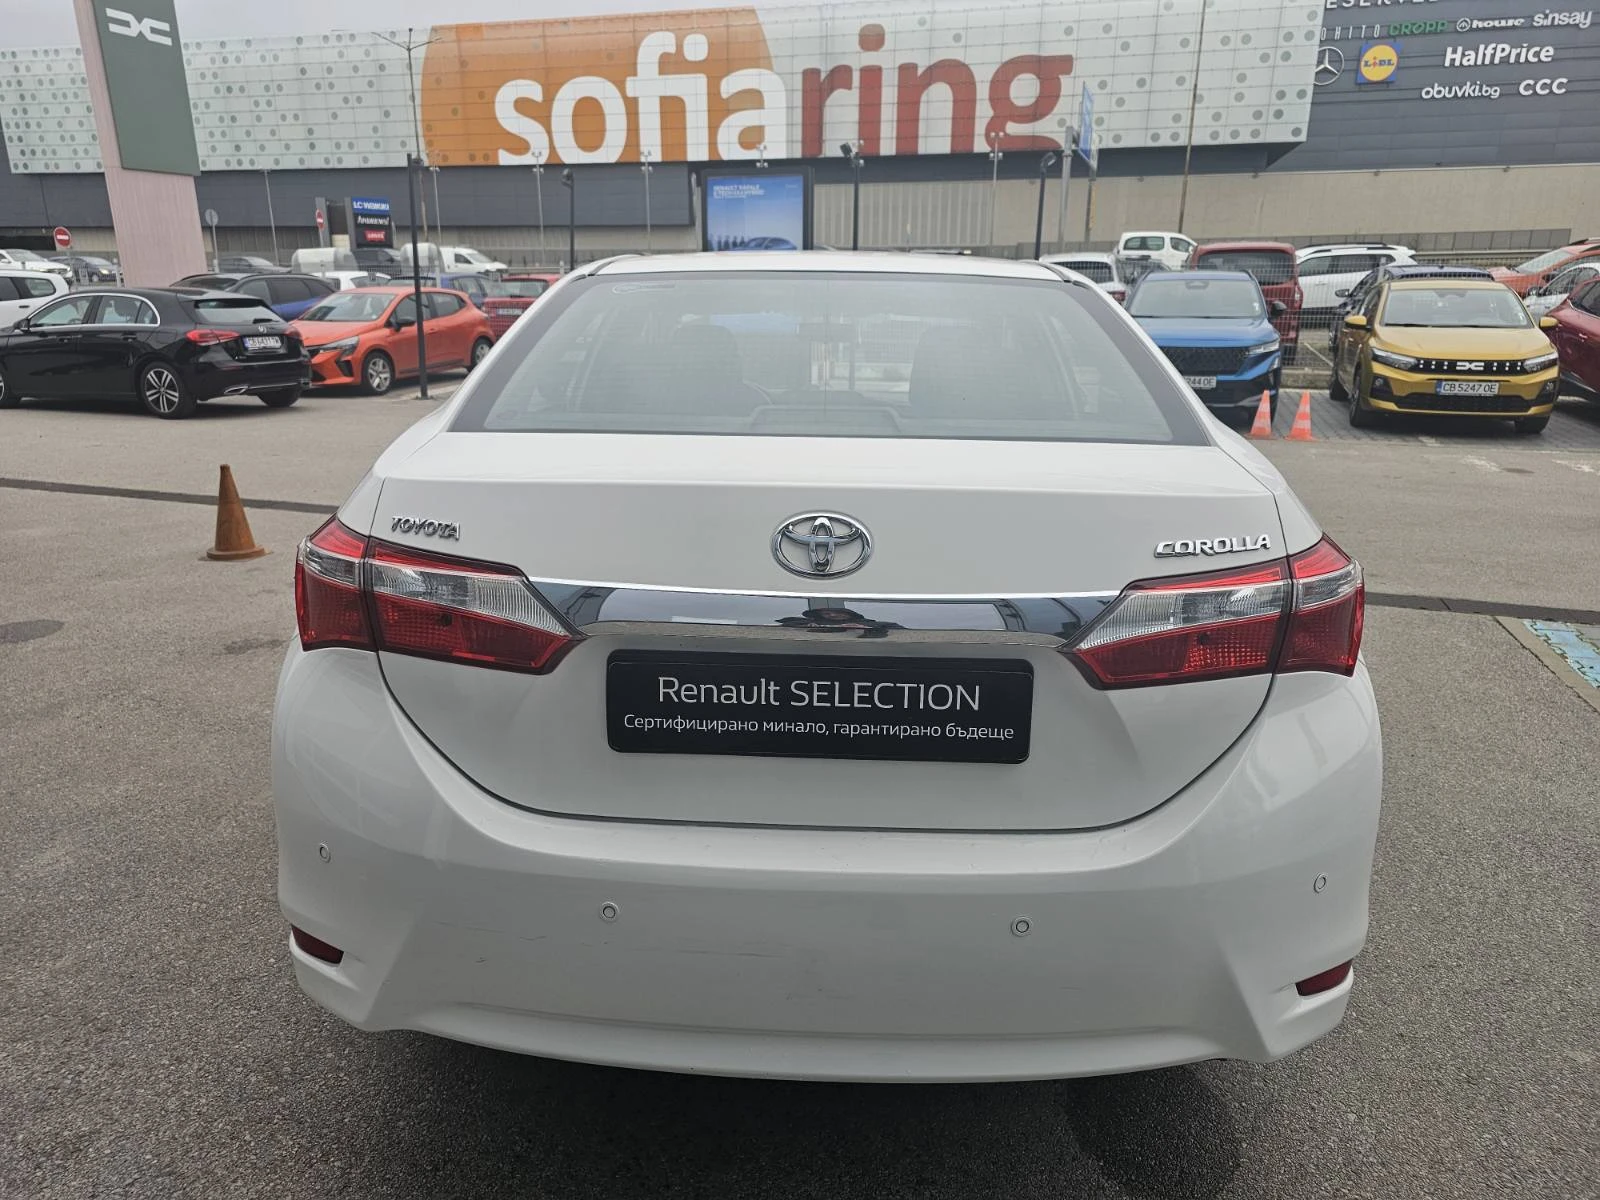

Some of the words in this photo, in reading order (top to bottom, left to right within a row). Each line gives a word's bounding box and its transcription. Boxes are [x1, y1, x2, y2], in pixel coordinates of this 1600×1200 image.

[1532, 9, 1592, 29] sinsay
[1444, 43, 1555, 68] HalfPrice
[1421, 81, 1500, 99] obuvki.bg
[1518, 77, 1568, 96] CCC
[391, 515, 461, 541] TOYOTA
[1154, 534, 1271, 558] COROLLA
[658, 676, 781, 706] Renault
[790, 680, 980, 711] SELECTION
[624, 714, 759, 734] Сертифицирано
[763, 719, 829, 736] минало,
[833, 722, 941, 740] гарантирано
[946, 722, 1014, 740] бъдеще
